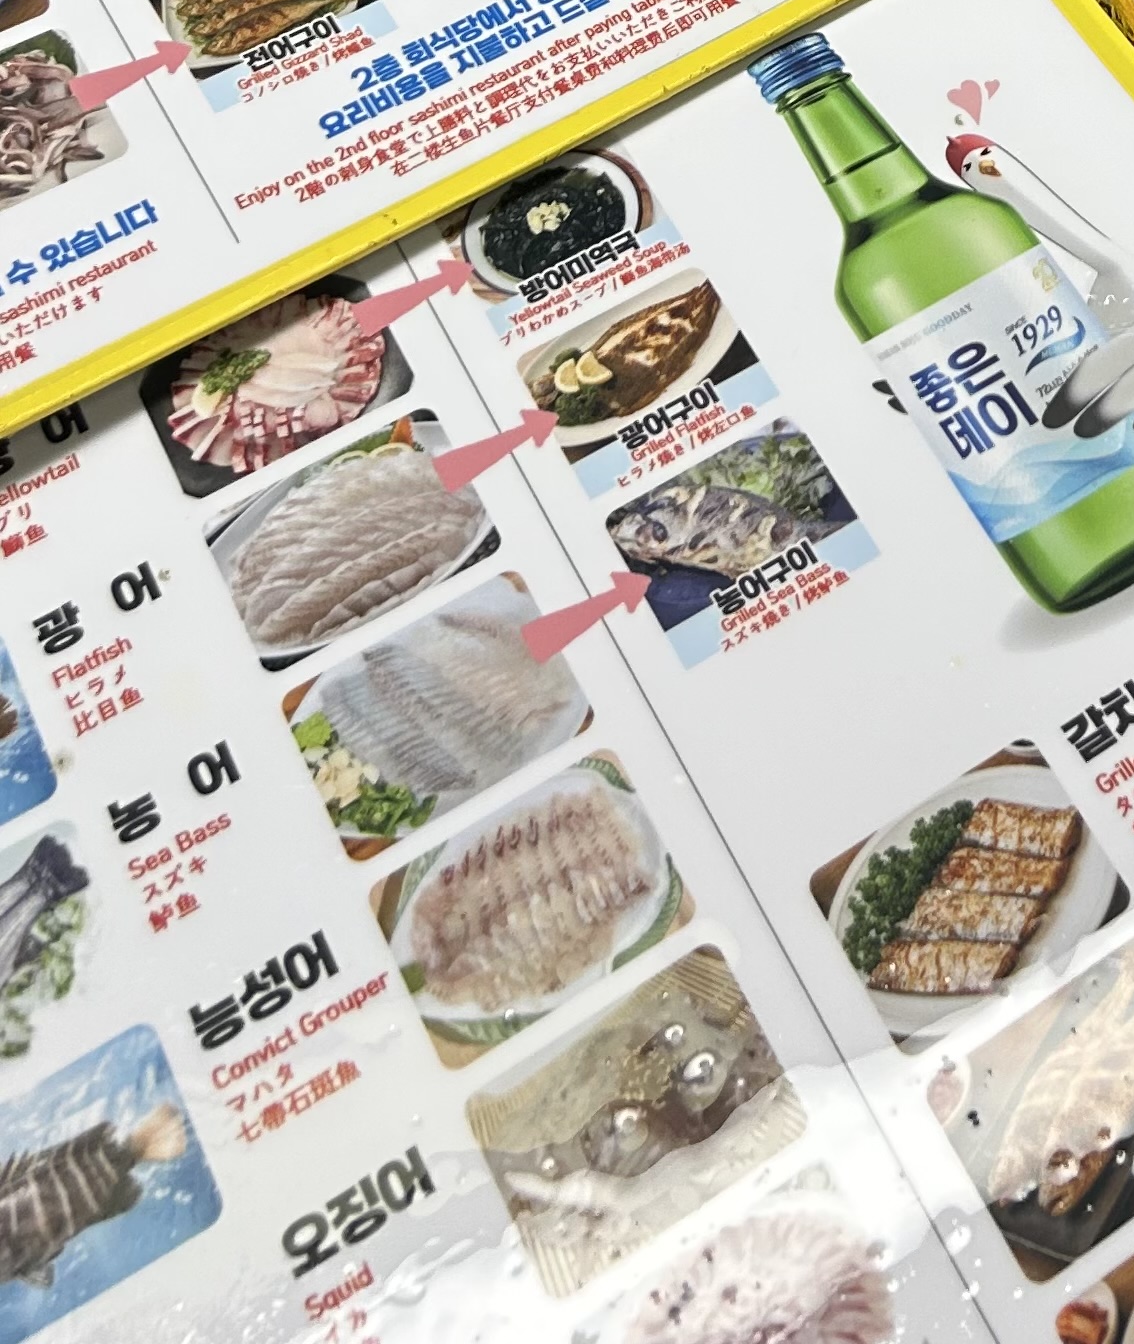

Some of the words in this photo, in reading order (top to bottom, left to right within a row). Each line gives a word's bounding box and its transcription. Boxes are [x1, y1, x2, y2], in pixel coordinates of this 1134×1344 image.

[237, 65, 280, 90] Grilled
[281, 42, 329, 69] Gizzard
[329, 25, 363, 48] Shad
[243, 15, 342, 71] 전어구이
[319, 59, 453, 139] 요리비용을
[450, 8, 556, 74] 지불하고
[350, 52, 403, 92] 2층
[234, 180, 281, 210] Enjoy
[283, 169, 305, 187] on
[306, 153, 335, 175] the
[335, 139, 368, 163] 2nd
[368, 121, 405, 146] floor
[407, 86, 469, 127] sashimi
[469, 49, 547, 98] restaurant
[548, 31, 582, 59] after
[584, 10, 633, 42] paying
[6, 258, 39, 285] 수
[40, 198, 159, 272] 있습니다
[517, 229, 641, 303] 방어미역국
[0, 280, 67, 324] sashimi
[68, 238, 159, 291] restaurant
[508, 287, 572, 327] Yellowtail
[572, 256, 633, 294] Seaweed
[632, 241, 667, 262] Soup
[1010, 304, 1064, 358] 1929
[909, 341, 1007, 414] 좋은
[617, 381, 720, 450] 광어구이
[630, 432, 675, 462] Grilled
[675, 404, 726, 438] Flatfish
[938, 380, 1039, 460] 데이
[712, 540, 819, 616] 농어구이
[721, 597, 767, 633] Grilled
[766, 584, 796, 605] Sea
[795, 562, 832, 589] Bass
[51, 635, 133, 688] Flatfish
[127, 846, 173, 880] Sea
[174, 812, 232, 853] Bass
[187, 928, 340, 1052] 능성어
[211, 1025, 298, 1090] Convict
[299, 970, 389, 1037] Grouper
[224, 1062, 295, 1113] マハタ
[281, 1144, 436, 1280] 오징어
[304, 1258, 375, 1321] Squid
